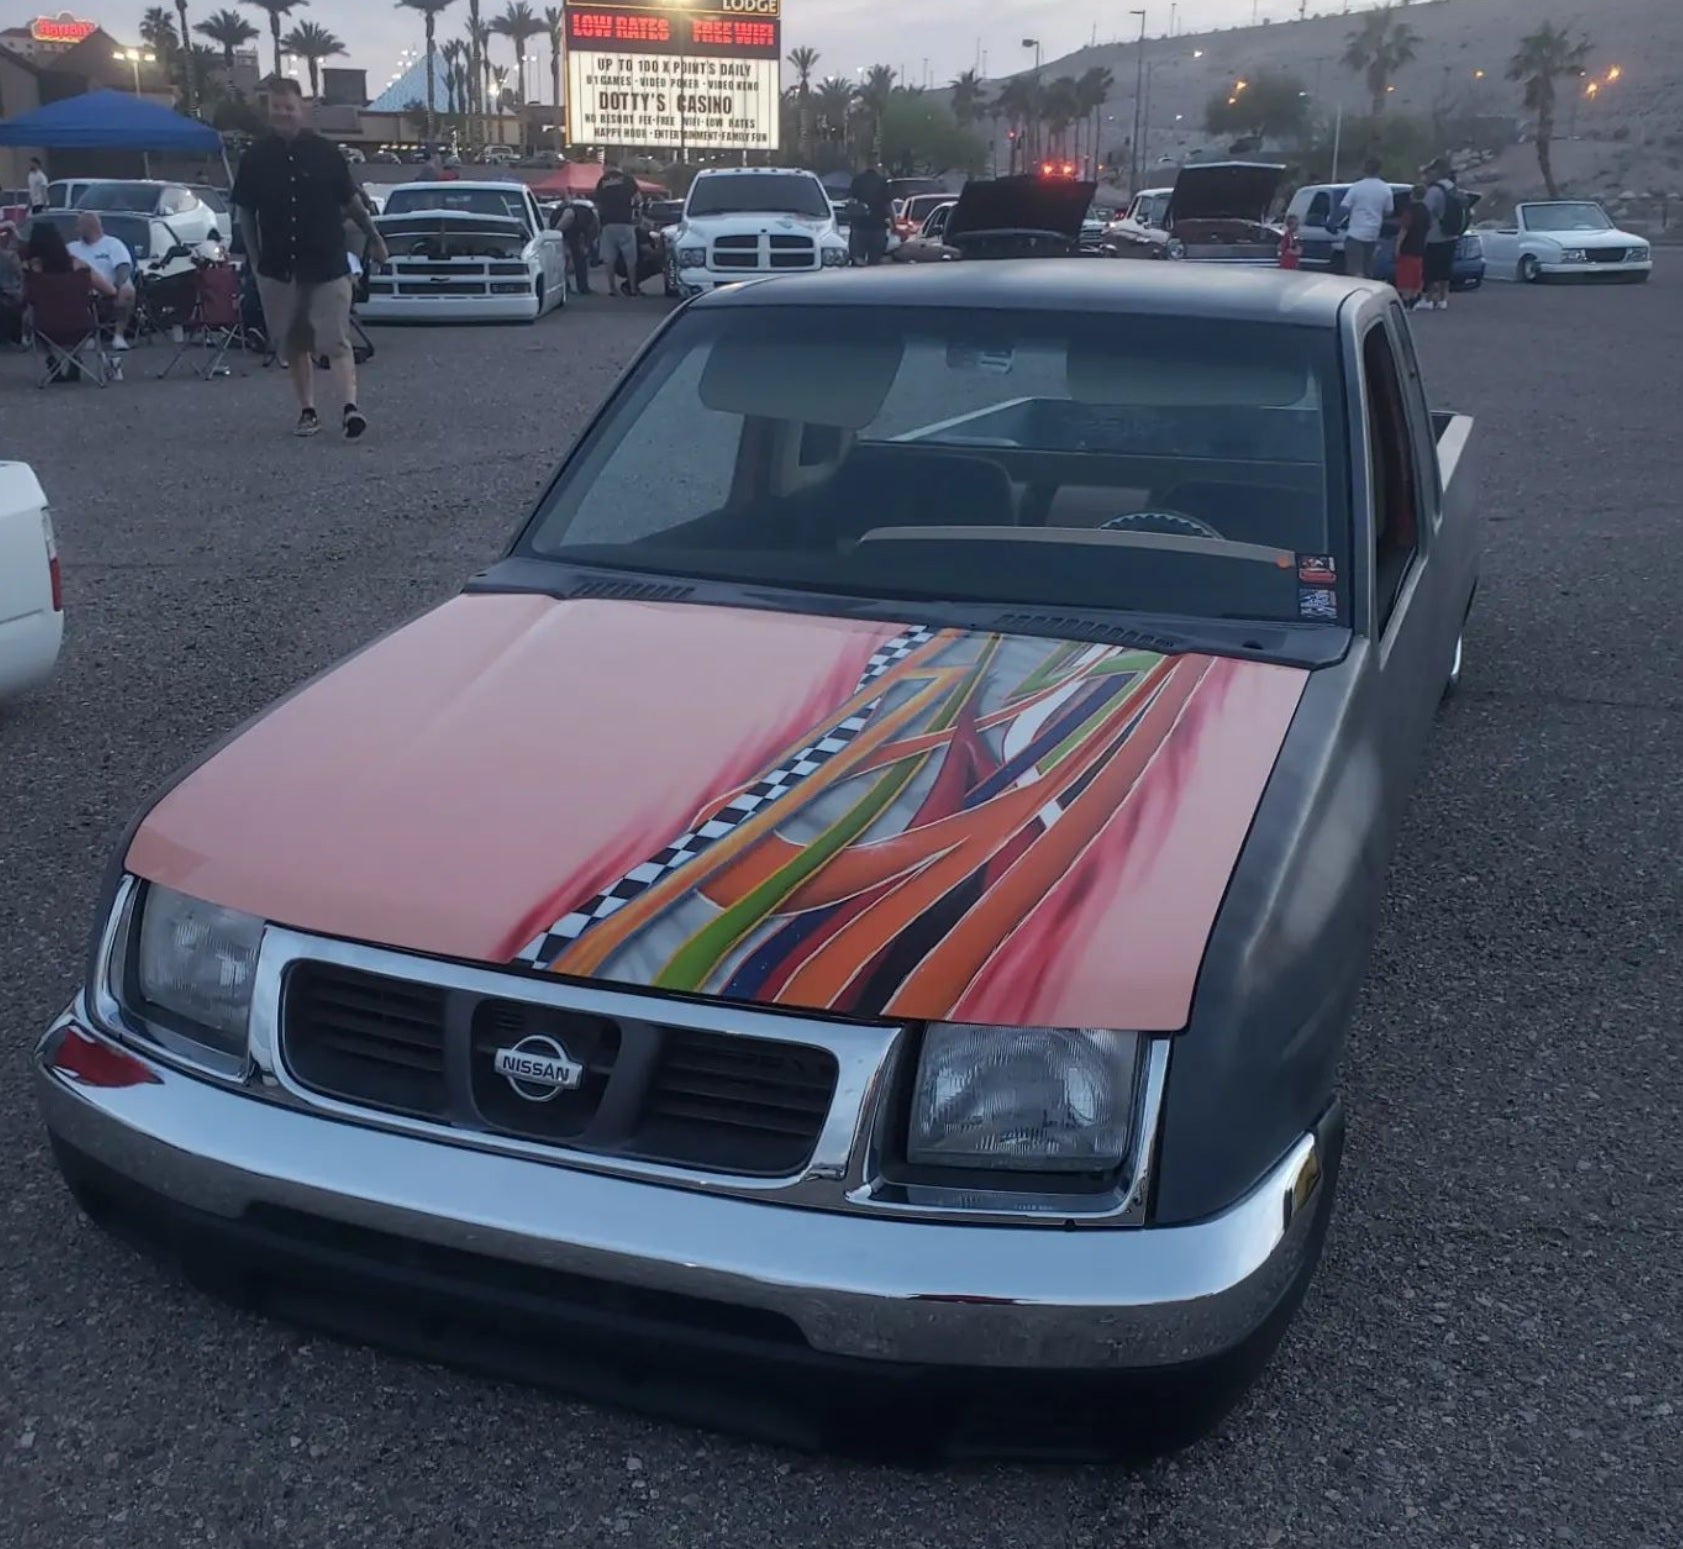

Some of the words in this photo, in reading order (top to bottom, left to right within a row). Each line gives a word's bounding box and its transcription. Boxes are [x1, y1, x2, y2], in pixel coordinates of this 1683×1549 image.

[722, 0, 777, 13] LODGE
[572, 14, 613, 37] LOW
[615, 16, 670, 41] RATES
[597, 58, 613, 71] UP
[618, 59, 633, 72] TO
[638, 60, 659, 73] 100
[662, 60, 670, 73] X
[720, 63, 752, 77] DAILY
[600, 74, 632, 86] GAMES
[639, 76, 666, 88] VIDEO
[670, 78, 699, 89] POKER
[707, 79, 735, 91] VIDEO
[599, 92, 666, 111] DOTTY'S
[676, 94, 732, 114] CASINO
[585, 113, 597, 124] NO
[600, 113, 634, 125] RESORT
[728, 118, 756, 129] RATES
[594, 127, 621, 138] HAPPY
[623, 128, 647, 139] HOUR
[502, 1055, 570, 1082] NISSAN
